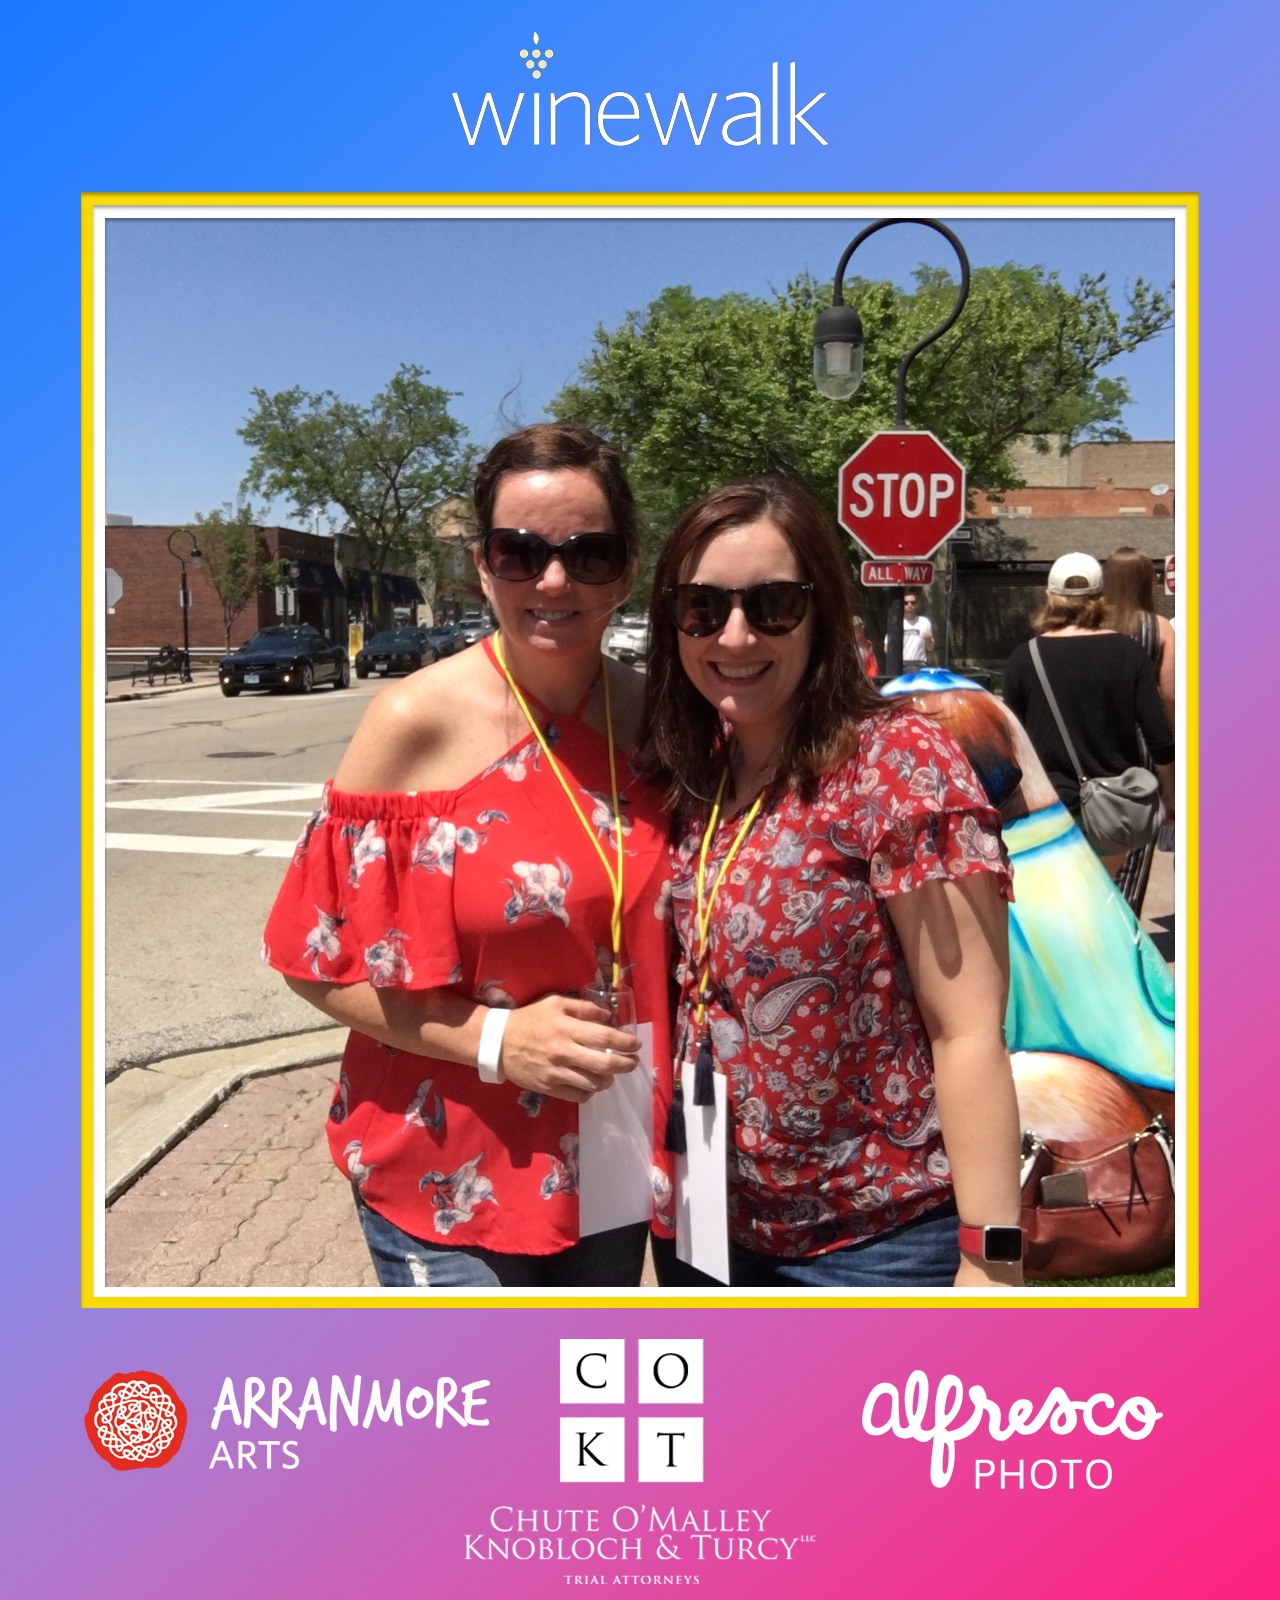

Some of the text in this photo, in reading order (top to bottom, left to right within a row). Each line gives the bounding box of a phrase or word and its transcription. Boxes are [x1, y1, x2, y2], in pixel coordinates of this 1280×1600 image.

[849, 472, 955, 519] STOP
[868, 566, 928, 581] ALL WAY
